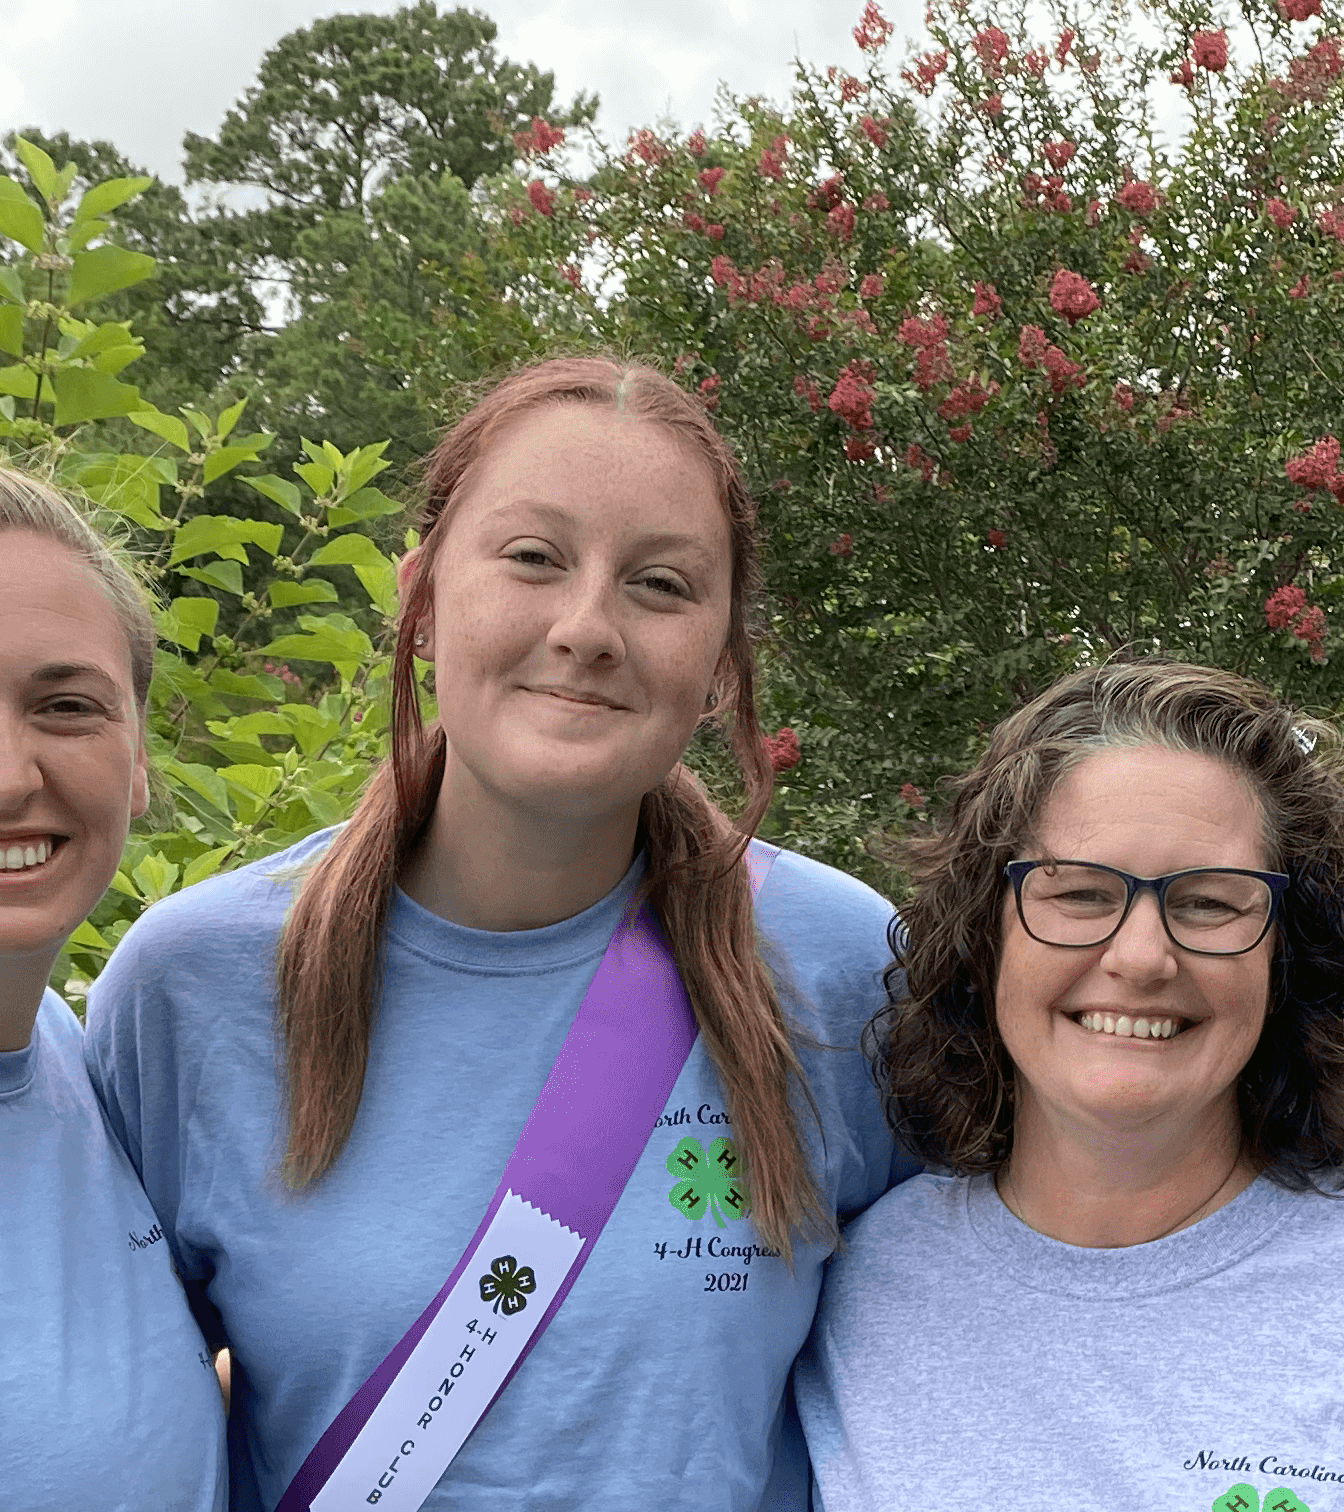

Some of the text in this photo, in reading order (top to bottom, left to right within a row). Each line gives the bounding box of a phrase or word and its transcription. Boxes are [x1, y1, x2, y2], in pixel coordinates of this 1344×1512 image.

[654, 1107, 691, 1128] orth
[653, 1237, 702, 1260] 4-H
[704, 1273, 749, 1292] 2021
[465, 1318, 497, 1345] 4-H
[417, 1344, 476, 1430] HONOR
[366, 1440, 415, 1505] CLUB
[1183, 1450, 1251, 1472] North
